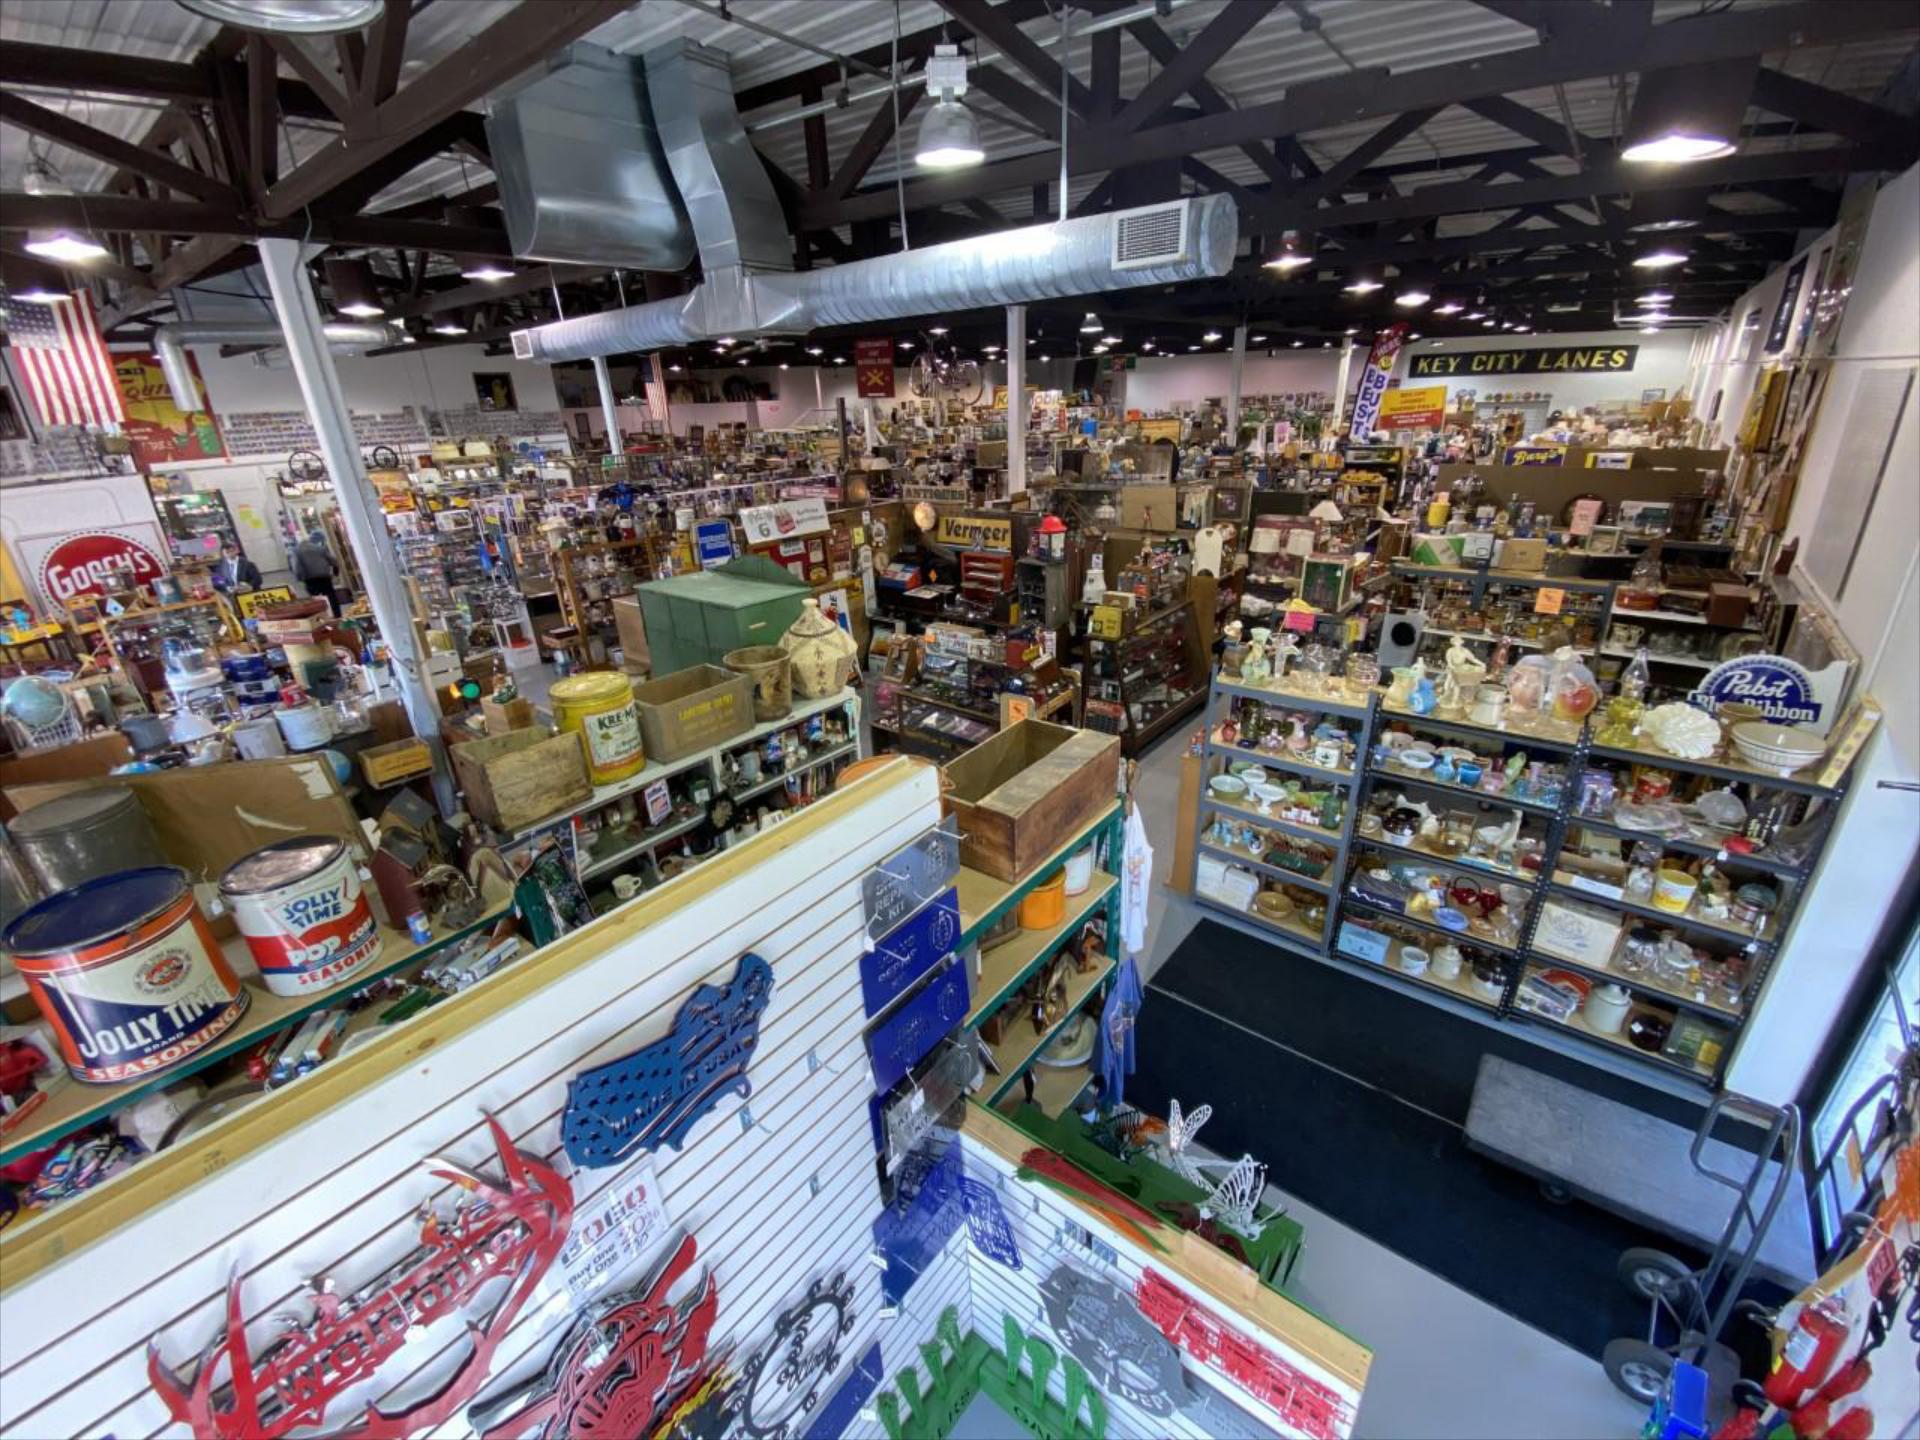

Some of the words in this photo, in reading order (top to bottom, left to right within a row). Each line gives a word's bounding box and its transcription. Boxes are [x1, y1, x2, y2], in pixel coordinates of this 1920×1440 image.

[1417, 356, 1460, 373] KEY
[1471, 353, 1525, 371] CITY
[1538, 349, 1628, 369] LANES
[945, 518, 1009, 542] Vermeer
[1722, 669, 1794, 699] Pabst
[283, 886, 341, 921] JOLLY
[291, 901, 343, 928] TIME
[287, 936, 341, 966] POP
[40, 971, 163, 1058] JOLLY
[91, 1005, 239, 1080] SEASONING
[143, 1031, 186, 1054] BRAND
